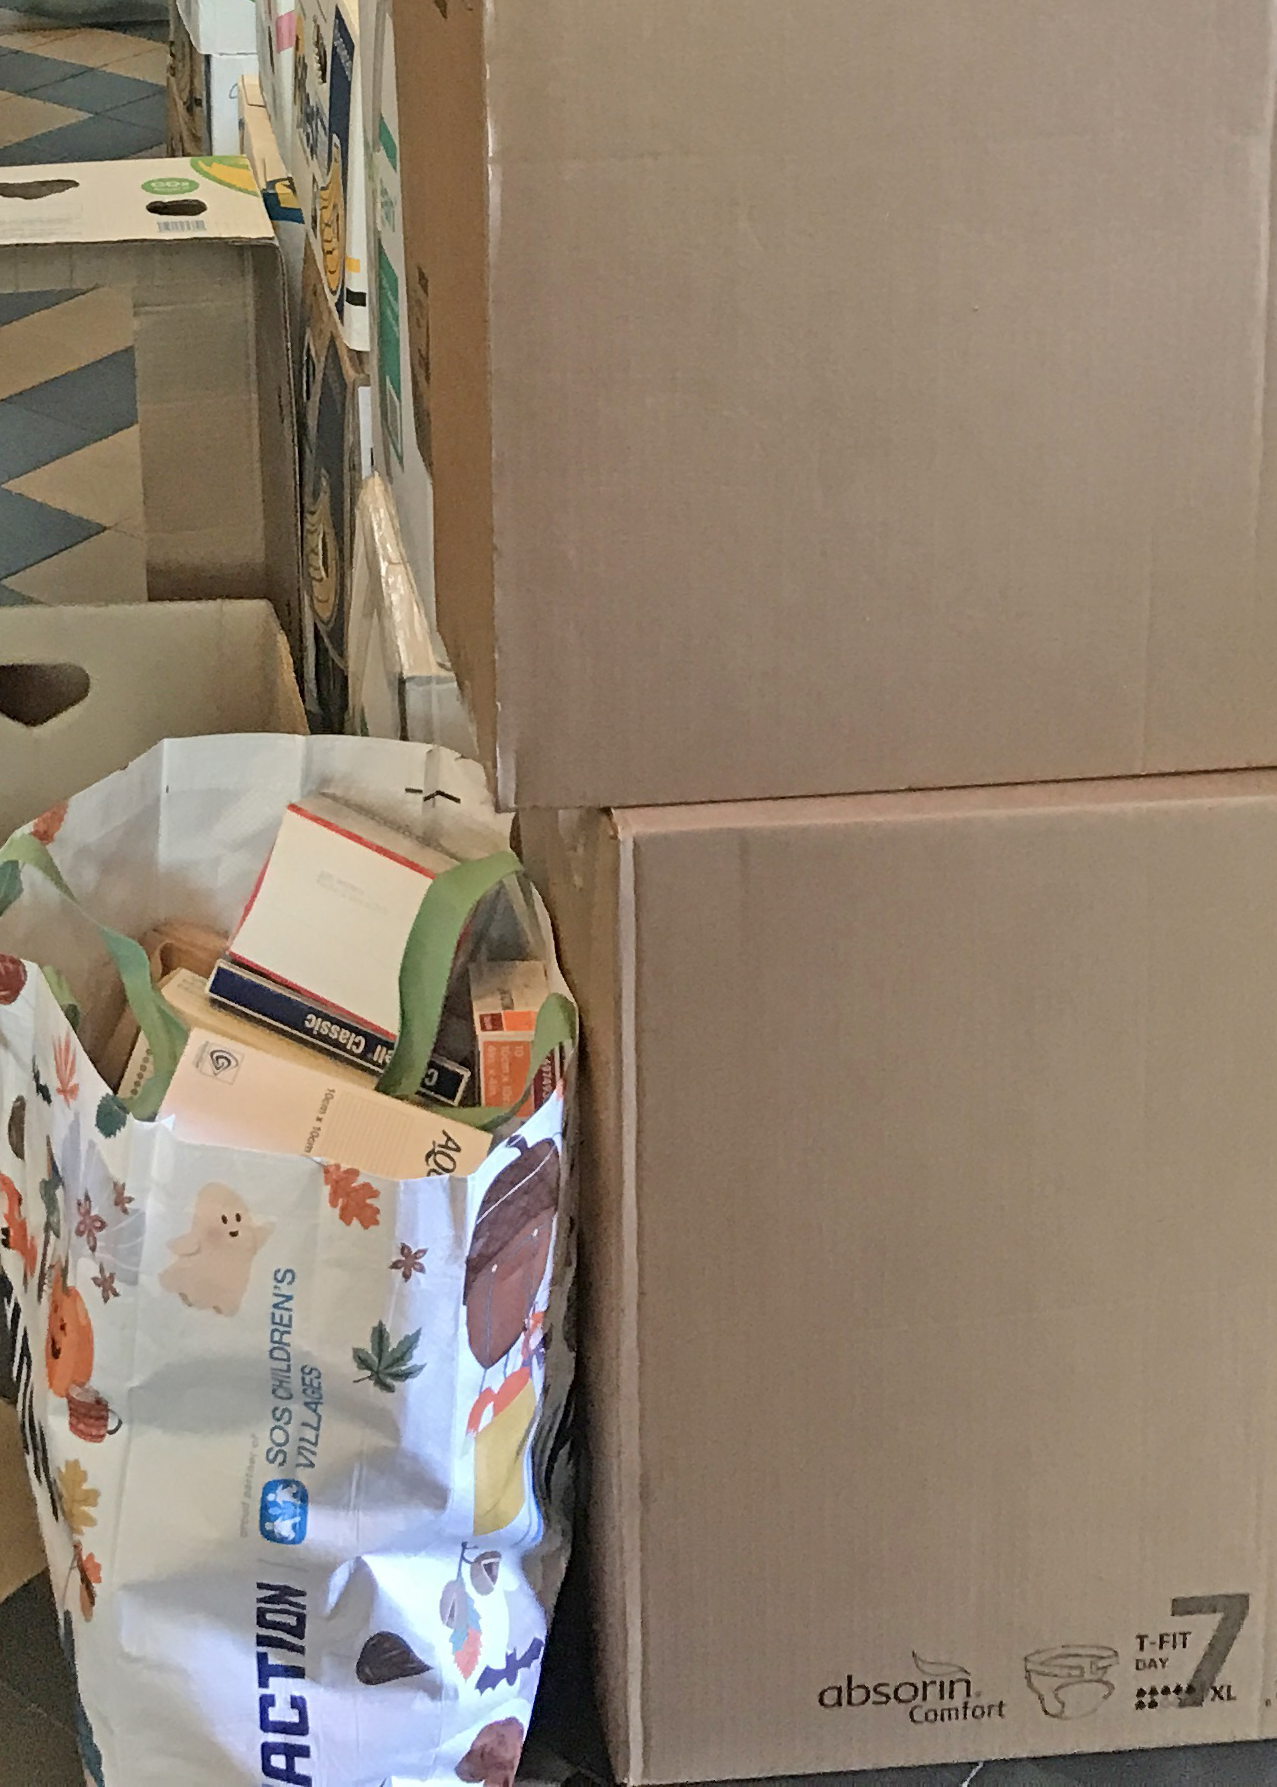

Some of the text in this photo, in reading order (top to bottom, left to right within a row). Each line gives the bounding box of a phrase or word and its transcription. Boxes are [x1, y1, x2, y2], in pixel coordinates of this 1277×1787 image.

[304, 1012, 365, 1055] Classic
[265, 1268, 296, 1468] SOS CHILDREN'S
[296, 1364, 323, 1469] VILLAGES
[1135, 1630, 1192, 1652] T-FIT
[1171, 1593, 1250, 1708] 7
[1135, 1657, 1170, 1671] DAY
[256, 1582, 312, 1787] ACTION
[817, 1674, 972, 1709] absorin
[1210, 1684, 1237, 1702] XL
[909, 1700, 1007, 1725] Comfort
